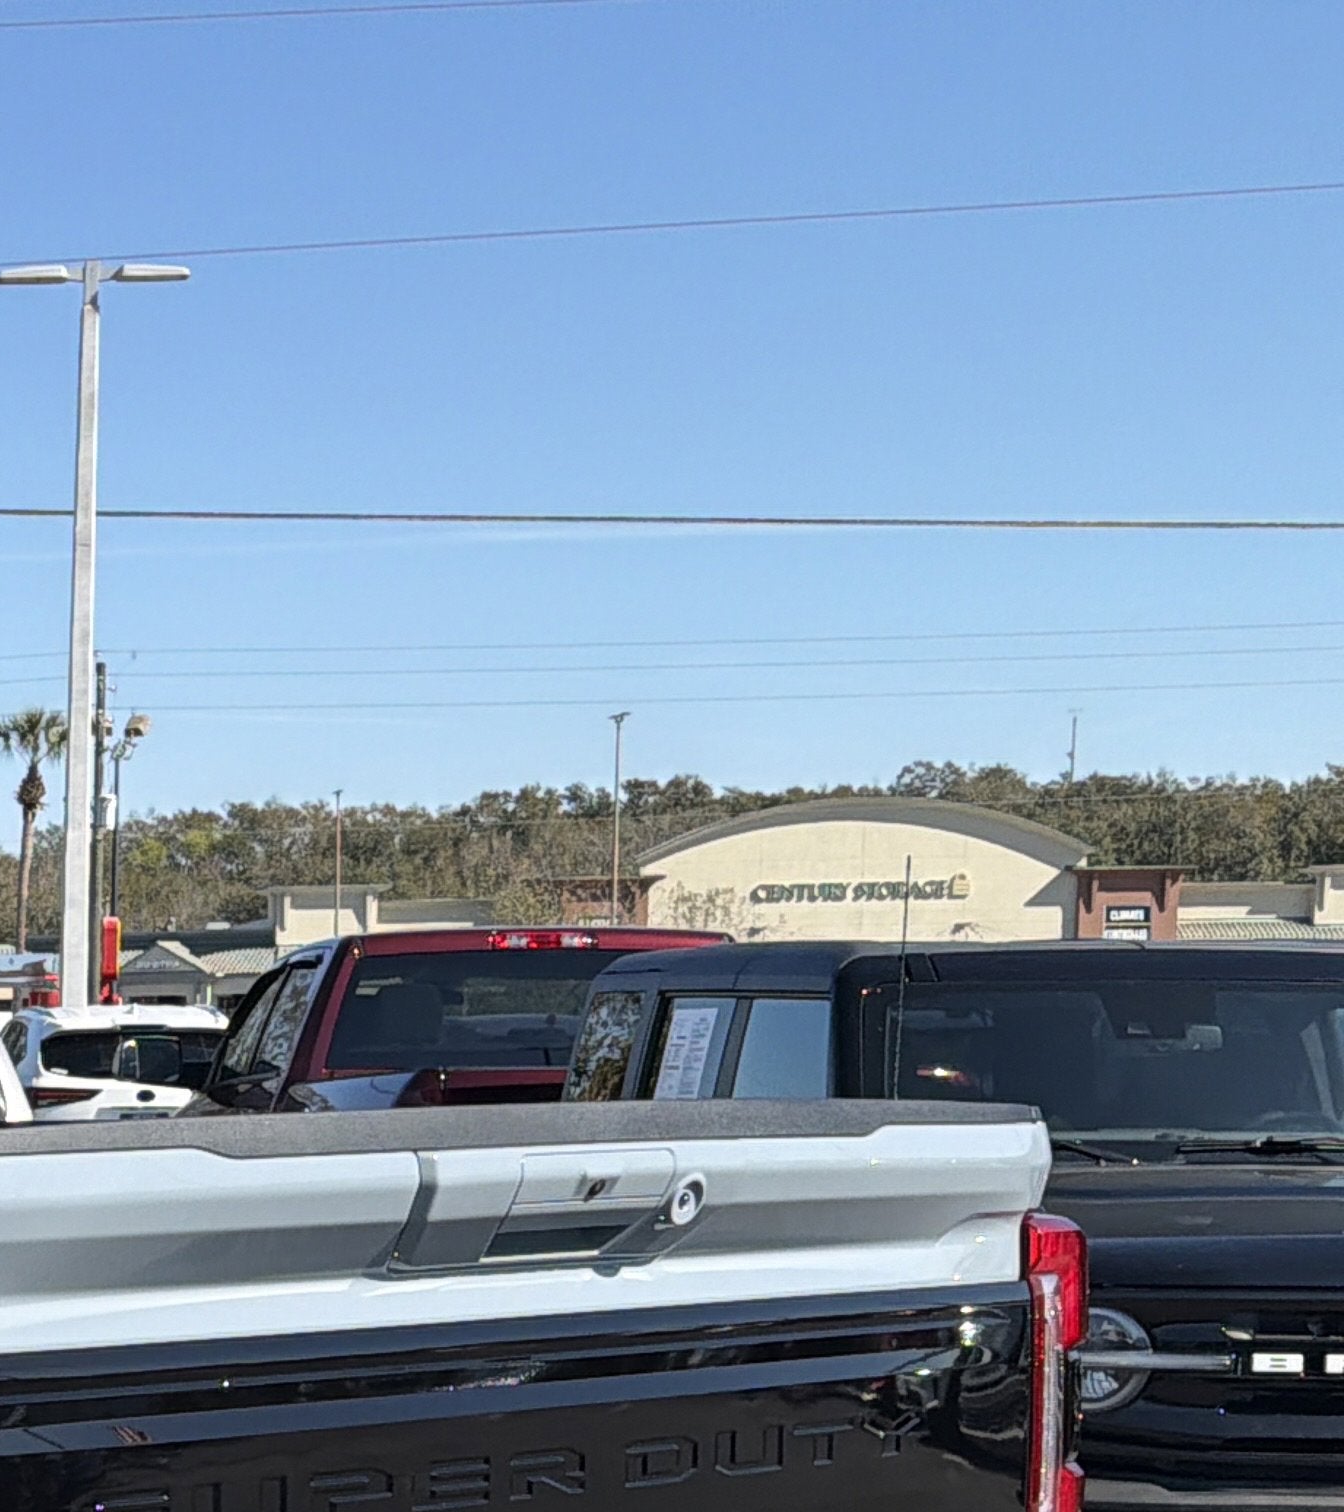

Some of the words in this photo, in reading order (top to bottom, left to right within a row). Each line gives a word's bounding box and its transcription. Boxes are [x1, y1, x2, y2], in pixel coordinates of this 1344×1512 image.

[749, 882, 851, 903] CENTURY
[852, 879, 949, 901] STORAGE
[624, 1410, 925, 1489] DUTY
